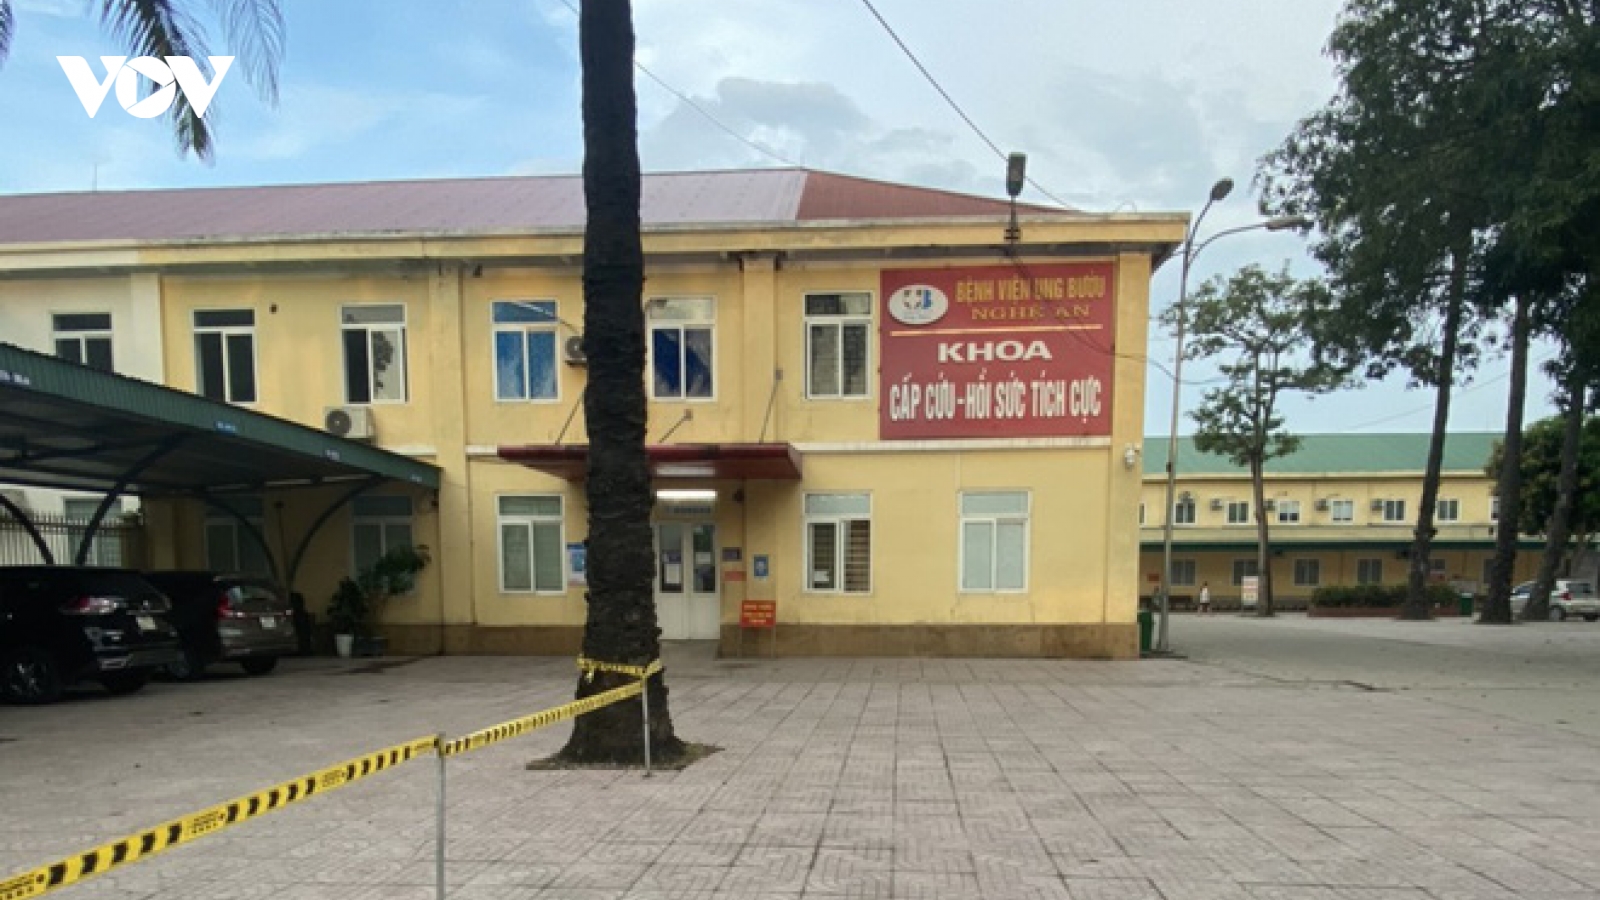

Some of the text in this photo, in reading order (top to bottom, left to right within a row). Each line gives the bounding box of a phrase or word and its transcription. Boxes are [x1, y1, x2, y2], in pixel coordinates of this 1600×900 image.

[1054, 304, 1089, 319] AN
[937, 340, 1052, 363] KHOA
[889, 372, 921, 421] CẤP
[925, 371, 956, 419] CỨU
[994, 370, 1026, 419] SỨC
[1030, 370, 1066, 417] TÍCH
[1069, 374, 1101, 424] CỰC
